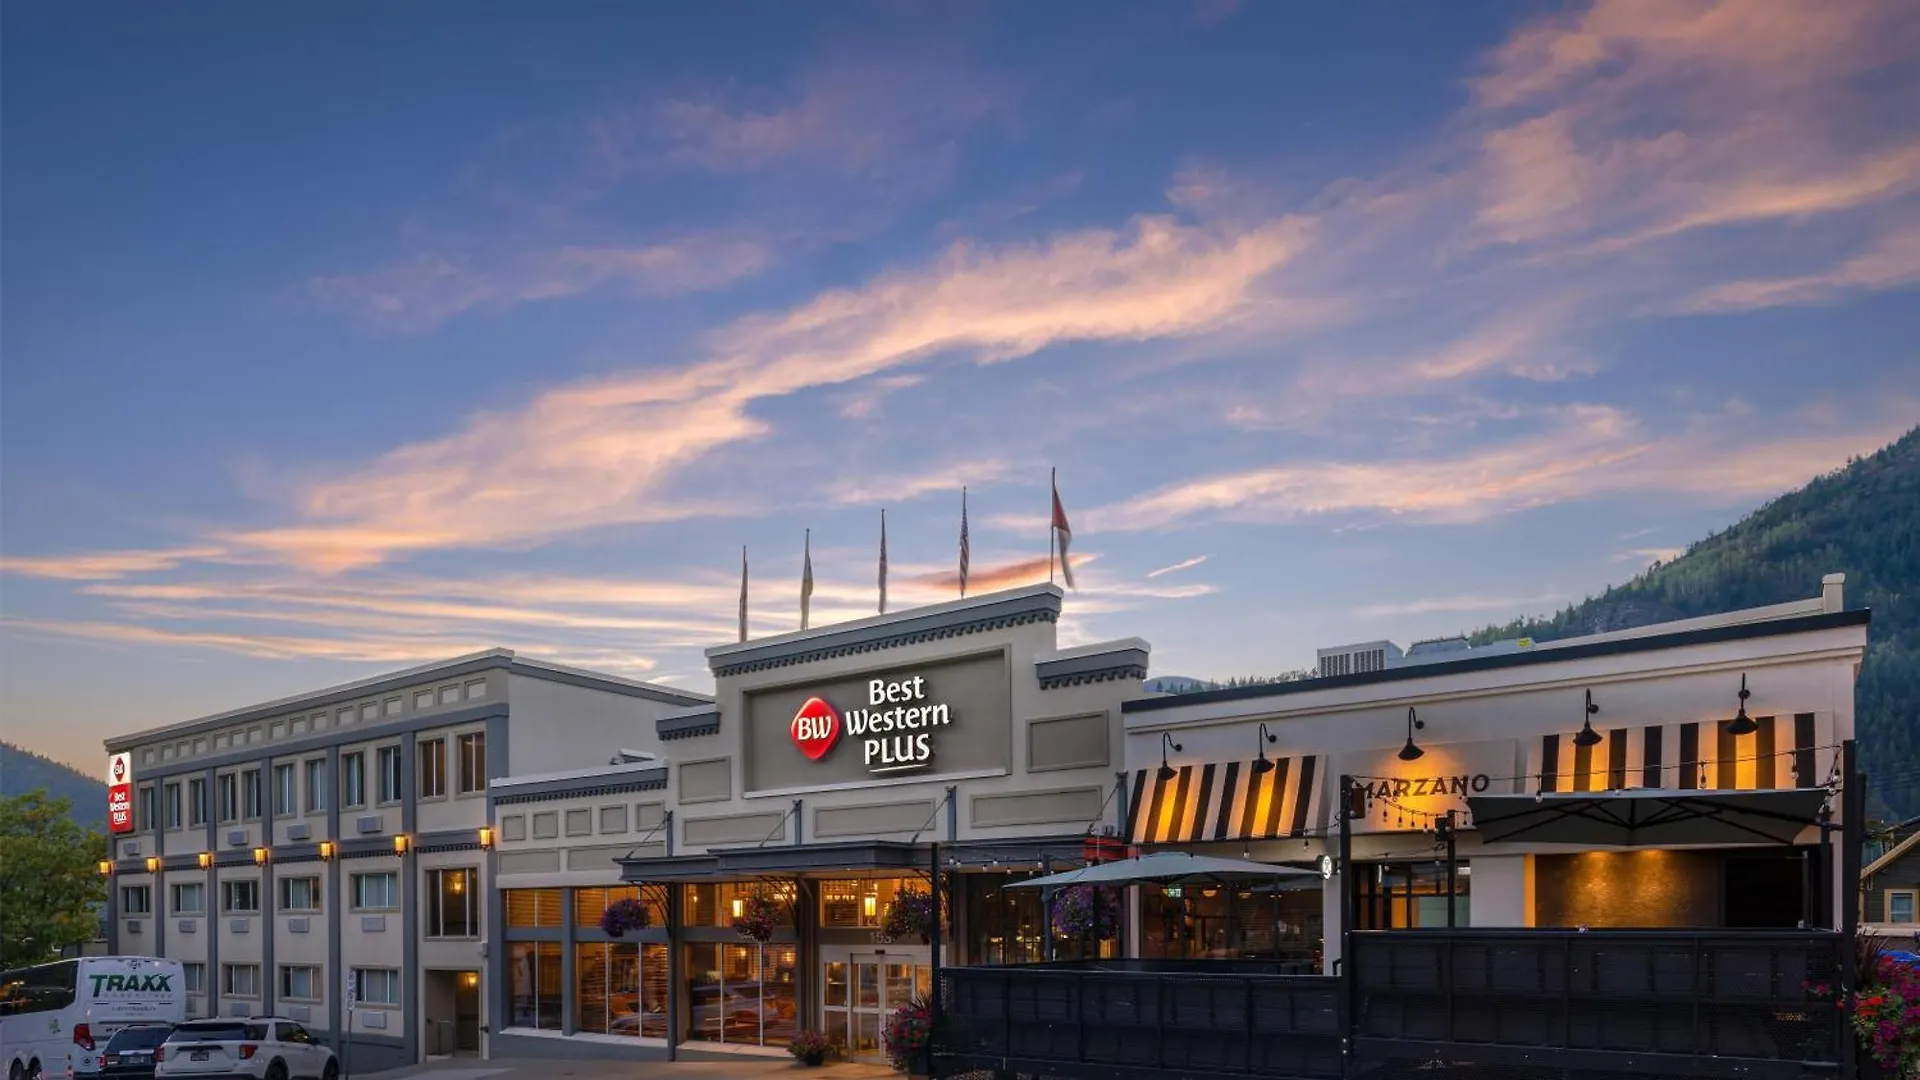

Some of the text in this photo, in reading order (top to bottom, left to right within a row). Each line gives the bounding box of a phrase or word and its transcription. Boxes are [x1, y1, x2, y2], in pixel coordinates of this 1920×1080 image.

[868, 675, 925, 706] Best
[797, 715, 832, 740] BW
[845, 703, 950, 736] Western
[864, 733, 930, 765] PLUS
[89, 974, 175, 997] TRAXX
